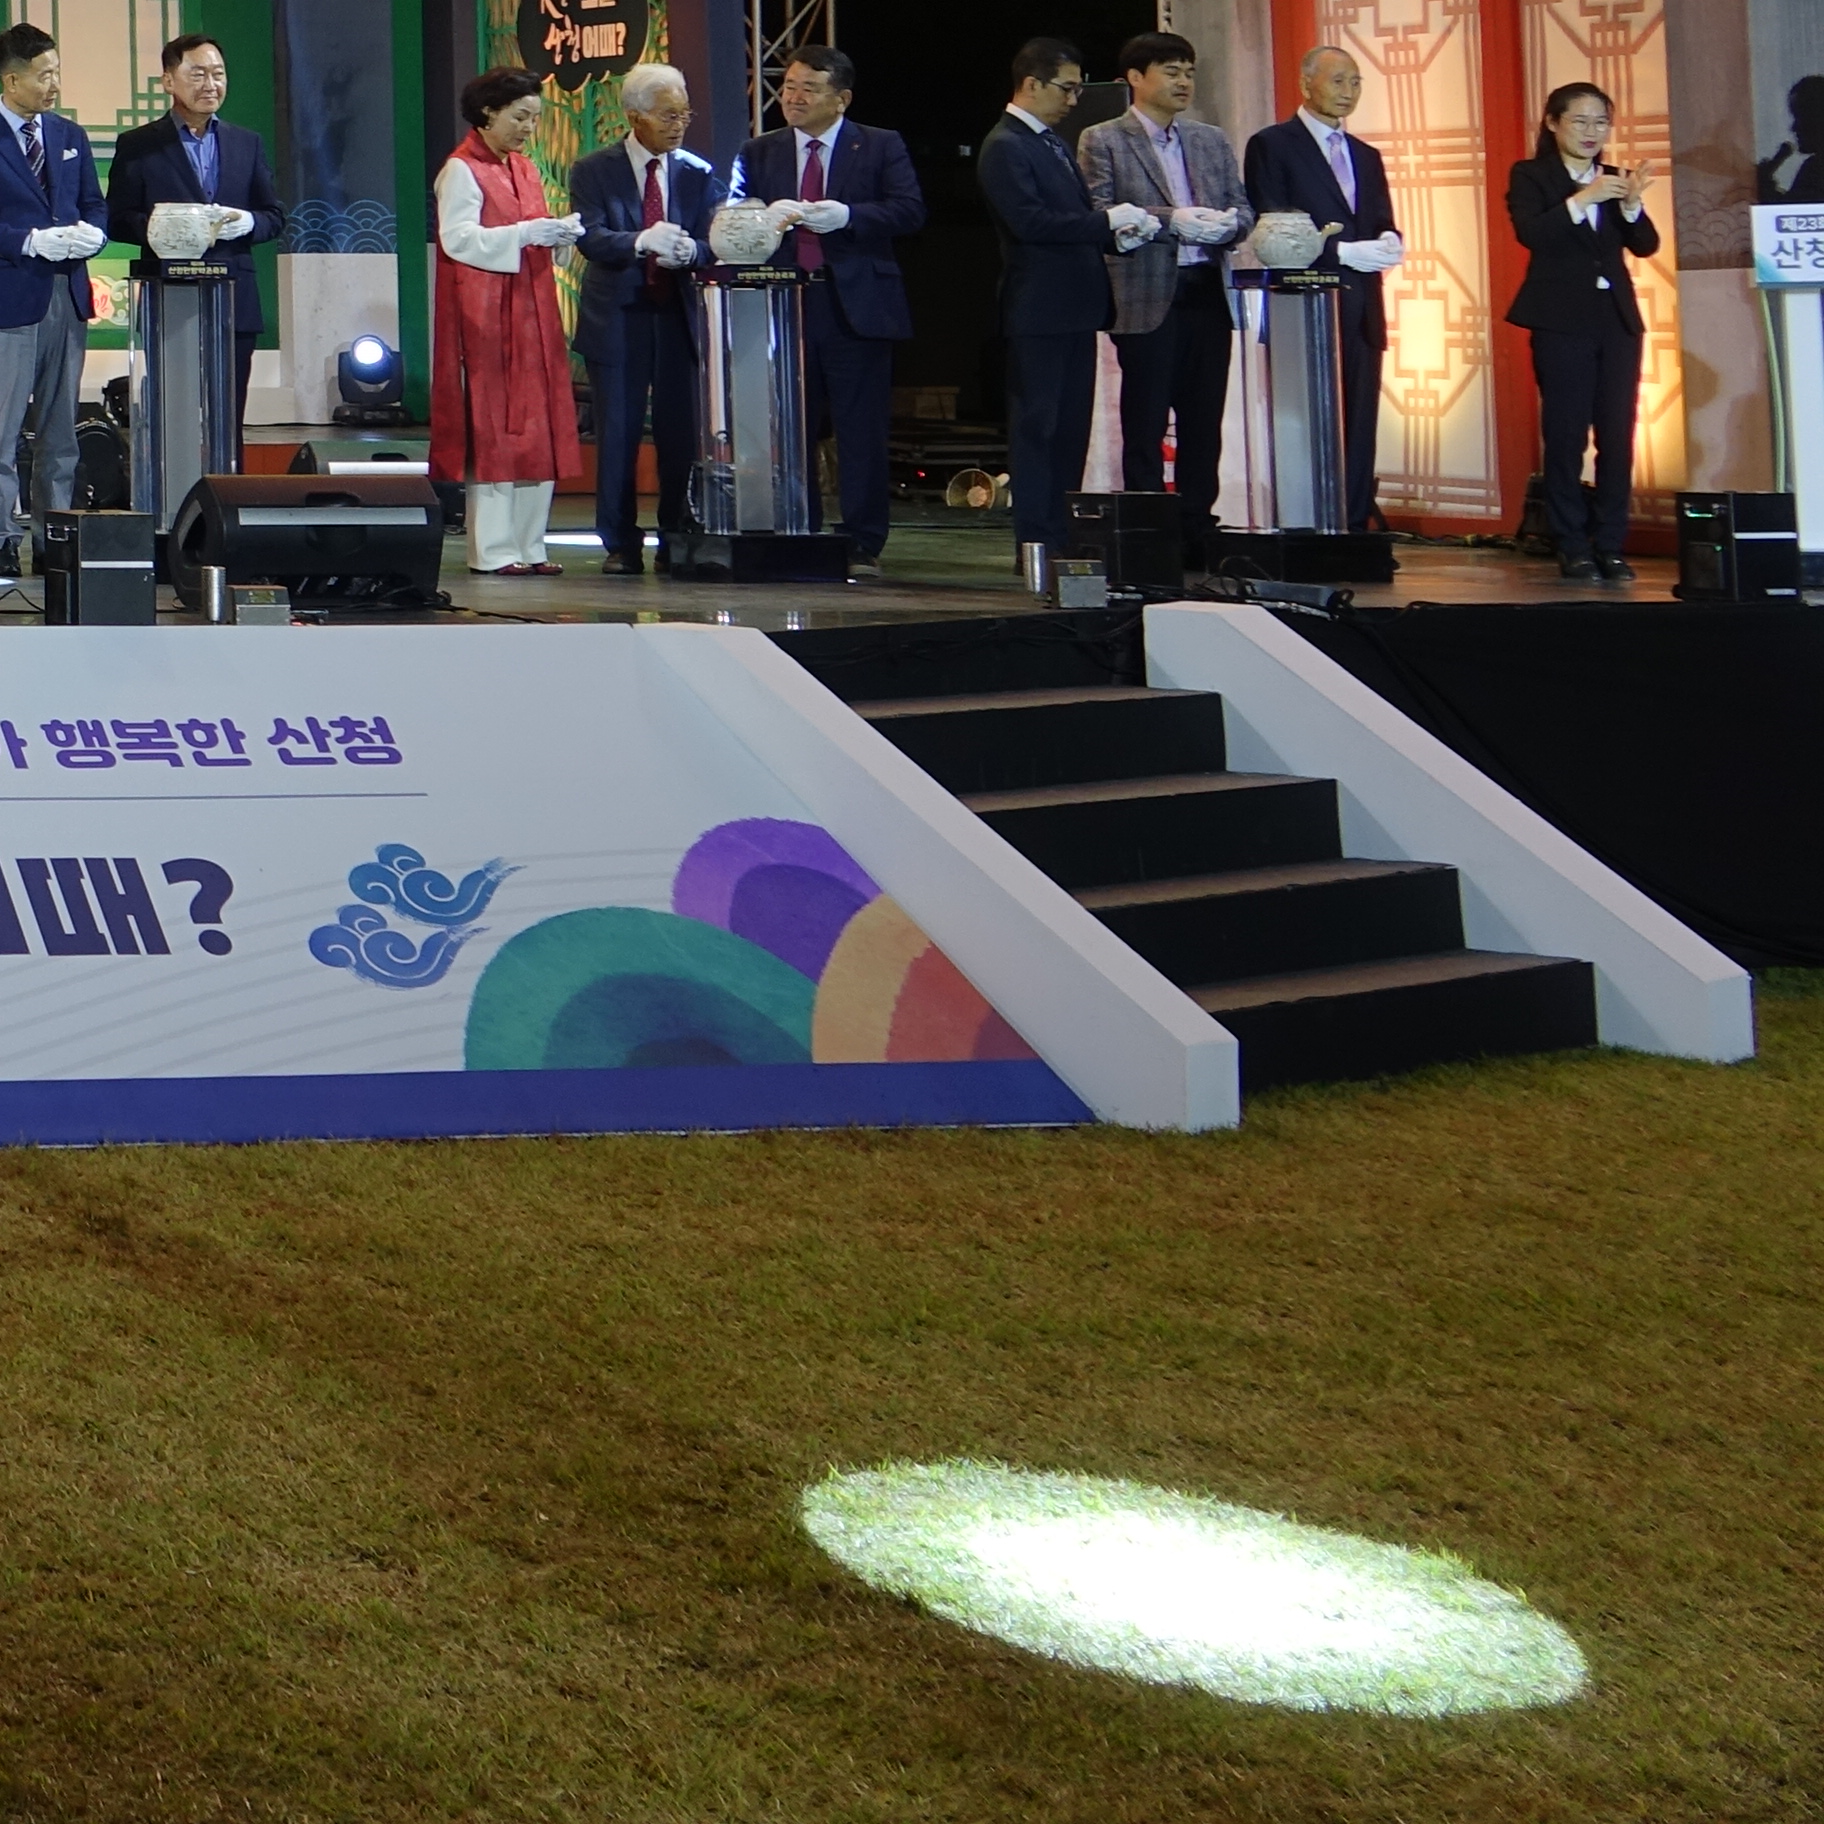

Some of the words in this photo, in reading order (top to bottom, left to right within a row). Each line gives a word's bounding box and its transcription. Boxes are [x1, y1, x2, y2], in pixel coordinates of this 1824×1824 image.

[543, 15, 581, 65] 산청
[581, 22, 627, 59] 어때?
[39, 717, 253, 769] 행복한
[266, 715, 403, 766] 산청
